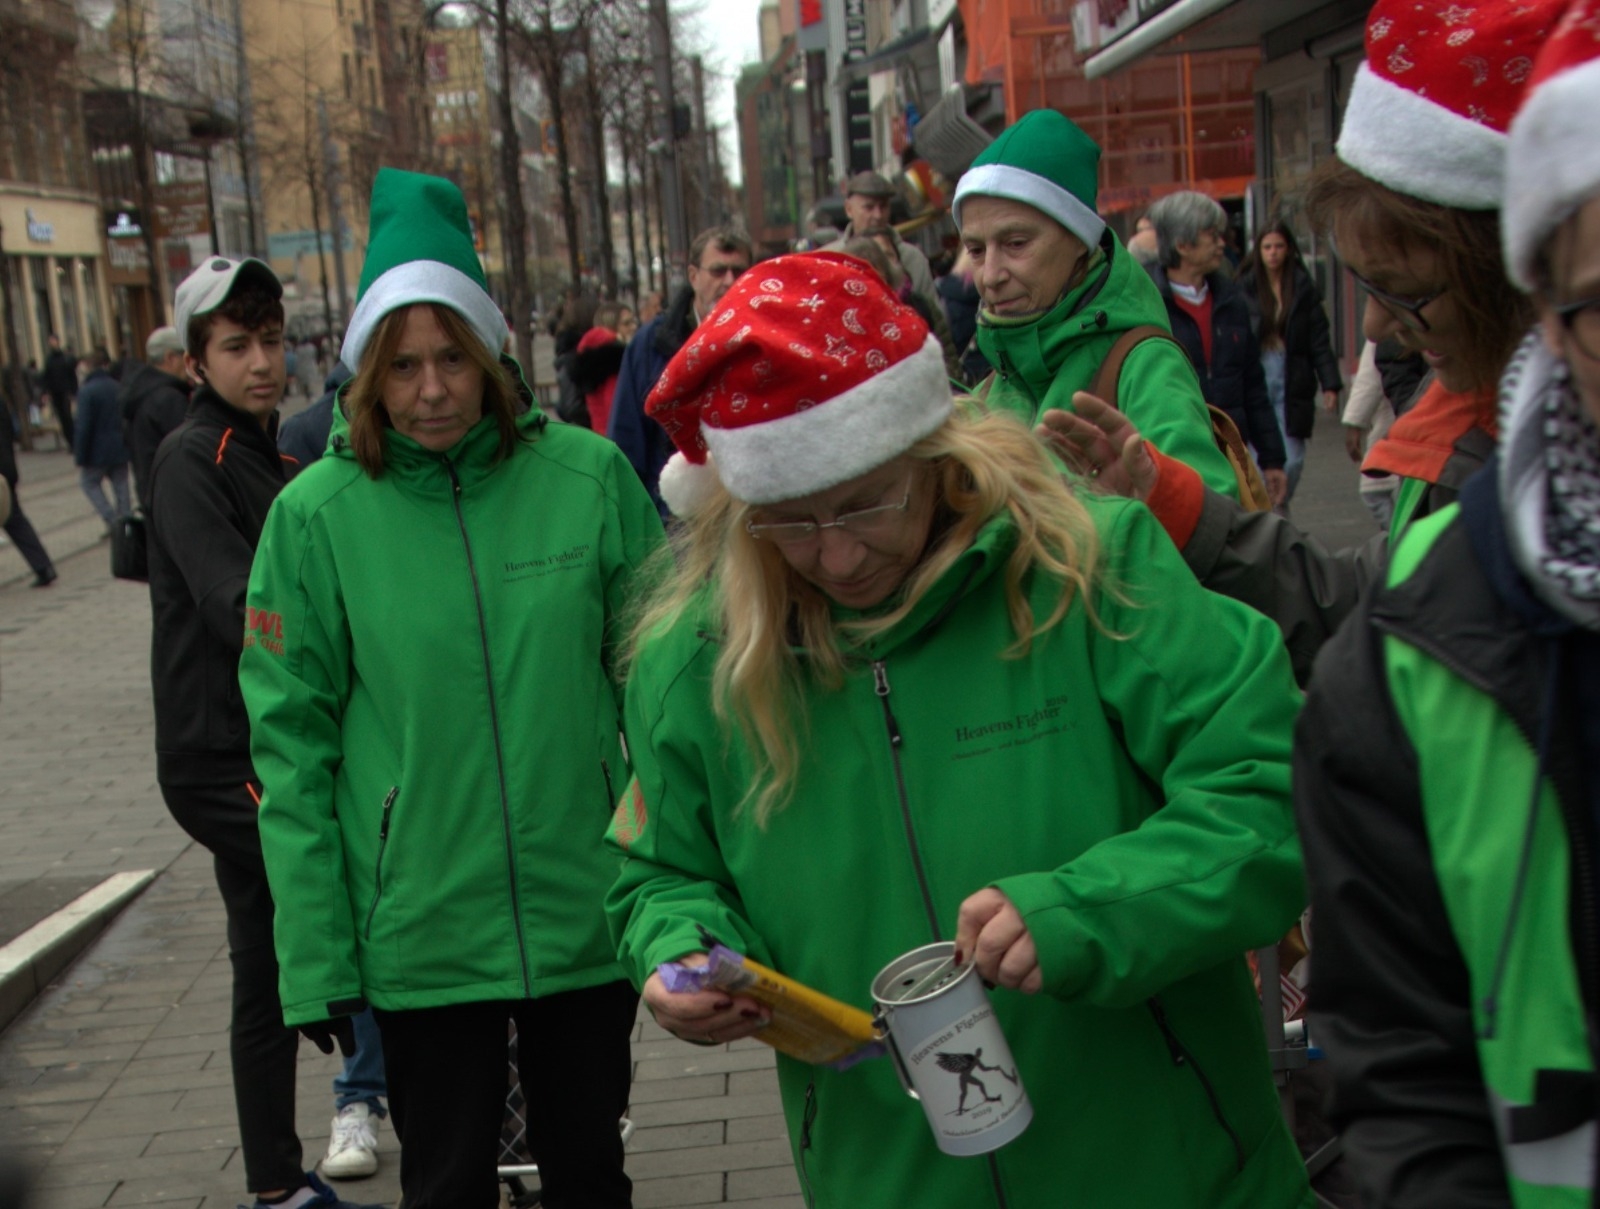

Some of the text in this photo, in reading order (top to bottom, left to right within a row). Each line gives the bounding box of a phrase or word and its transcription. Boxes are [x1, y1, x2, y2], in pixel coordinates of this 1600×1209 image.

[505, 560, 545, 571] Heavens
[548, 551, 584, 564] Fighter
[1045, 695, 1068, 707] 2019
[955, 721, 1014, 742] Heavens
[1015, 707, 1061, 730] Fighter
[911, 1031, 954, 1065] Heavens
[971, 1106, 993, 1120] 2019
